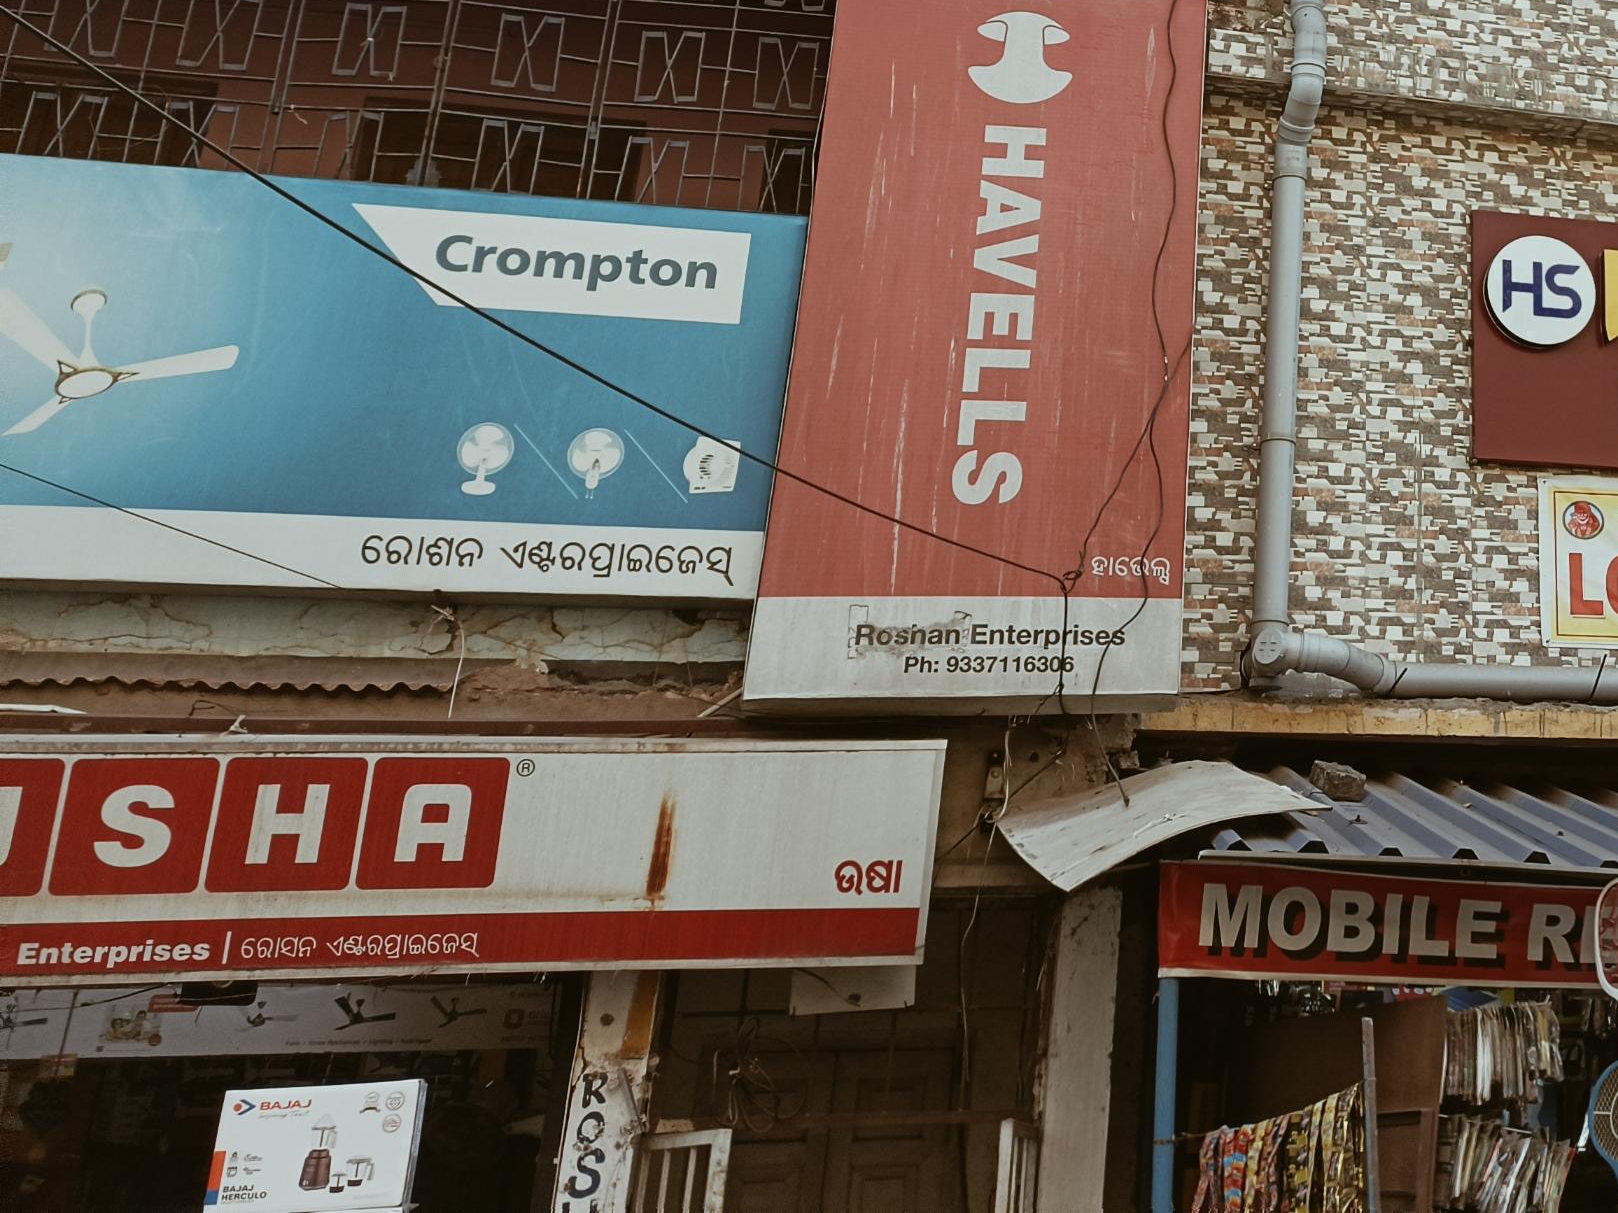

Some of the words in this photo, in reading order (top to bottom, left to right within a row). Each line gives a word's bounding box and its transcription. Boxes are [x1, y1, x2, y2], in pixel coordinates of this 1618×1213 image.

[435, 233, 719, 292] Crompton
[1500, 257, 1583, 320] HS
[951, 124, 1047, 506] HAVELLS
[360, 534, 484, 568] ରୋଶନ
[854, 623, 961, 647] Roshan
[970, 623, 1126, 650] Enterprises
[903, 655, 939, 673] Ph:
[946, 655, 1075, 673] 9337116306
[834, 859, 903, 896] ଉଷା
[1198, 882, 1504, 963] MOBILE
[16, 938, 211, 969] Enterprises
[240, 934, 317, 962] ରୋସନ
[259, 1098, 313, 1111] BAJAJ
[564, 1070, 609, 1213] ROS
[220, 1190, 268, 1202] HERCULO
[222, 1184, 255, 1193] BAJAJ
